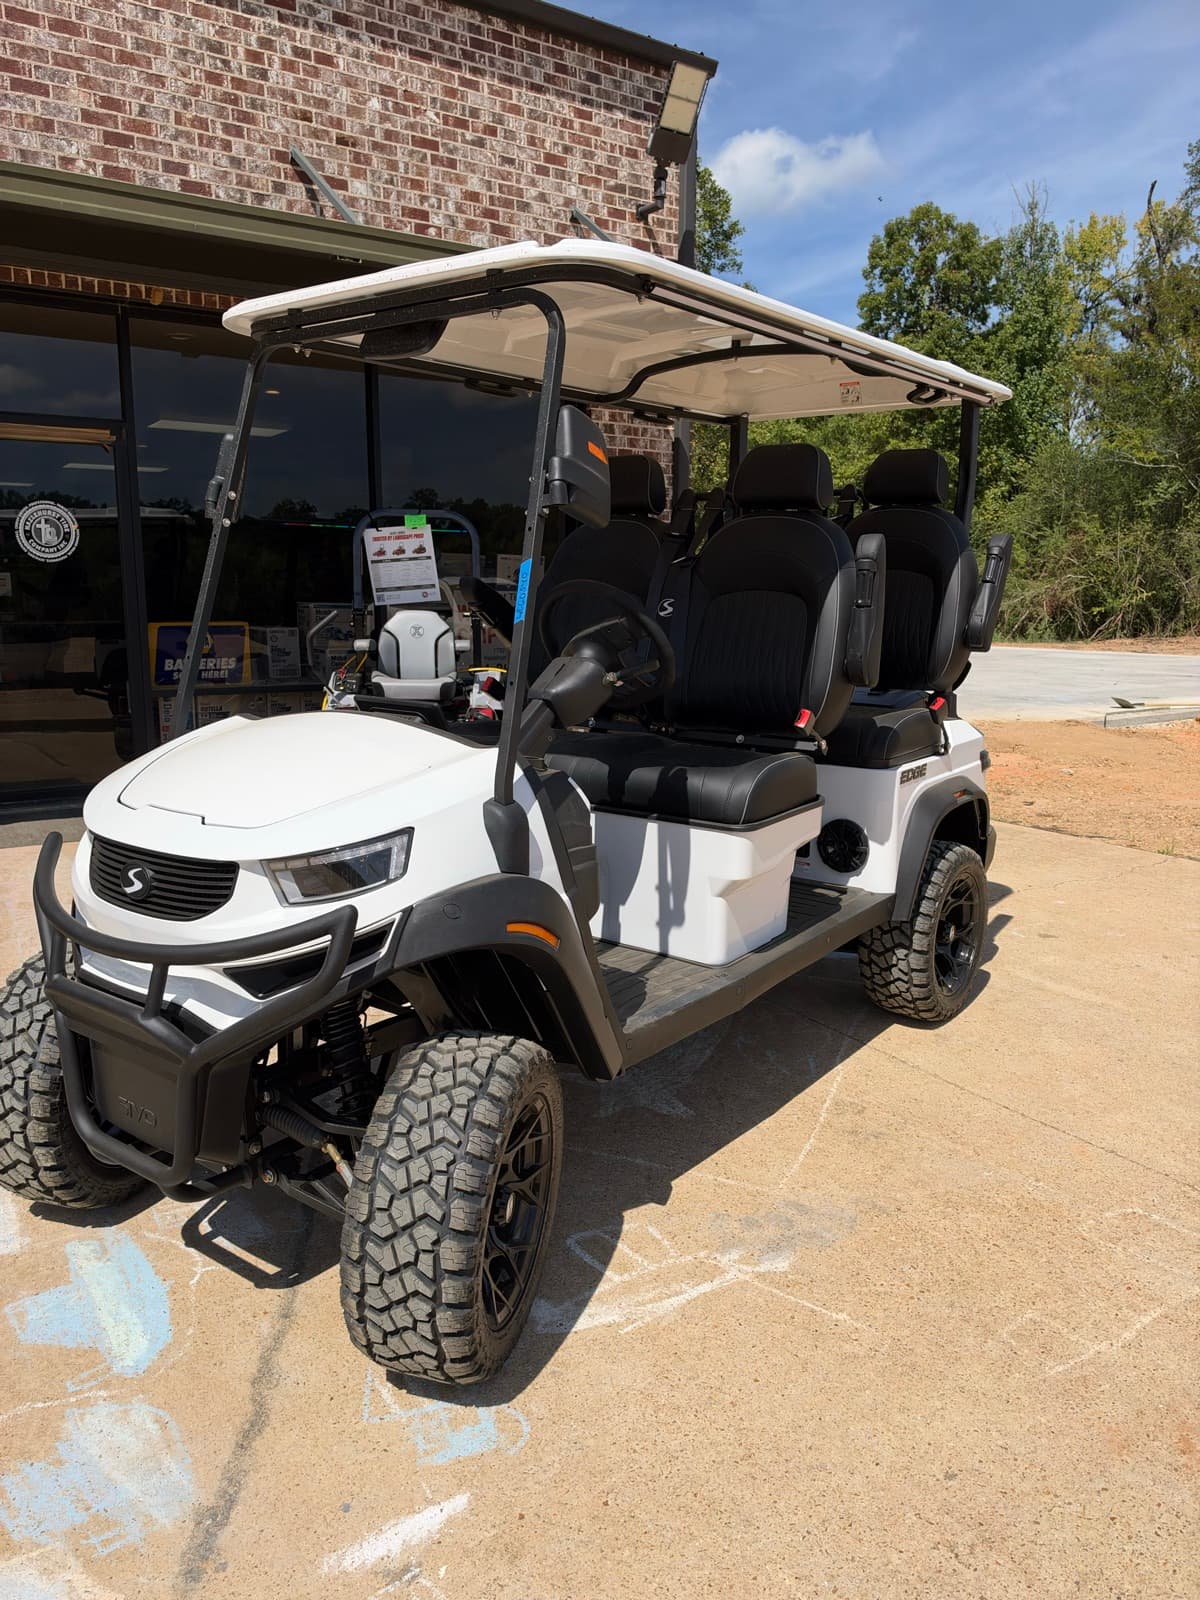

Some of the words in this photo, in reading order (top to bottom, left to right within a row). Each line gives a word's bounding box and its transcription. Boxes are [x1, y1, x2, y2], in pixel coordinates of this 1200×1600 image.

[60, 517, 70, 533] TIRE
[29, 539, 58, 553] COMPANY
[164, 657, 237, 671] BAERIES
[201, 670, 229, 679] HERE!
[900, 763, 928, 785] EDGE
